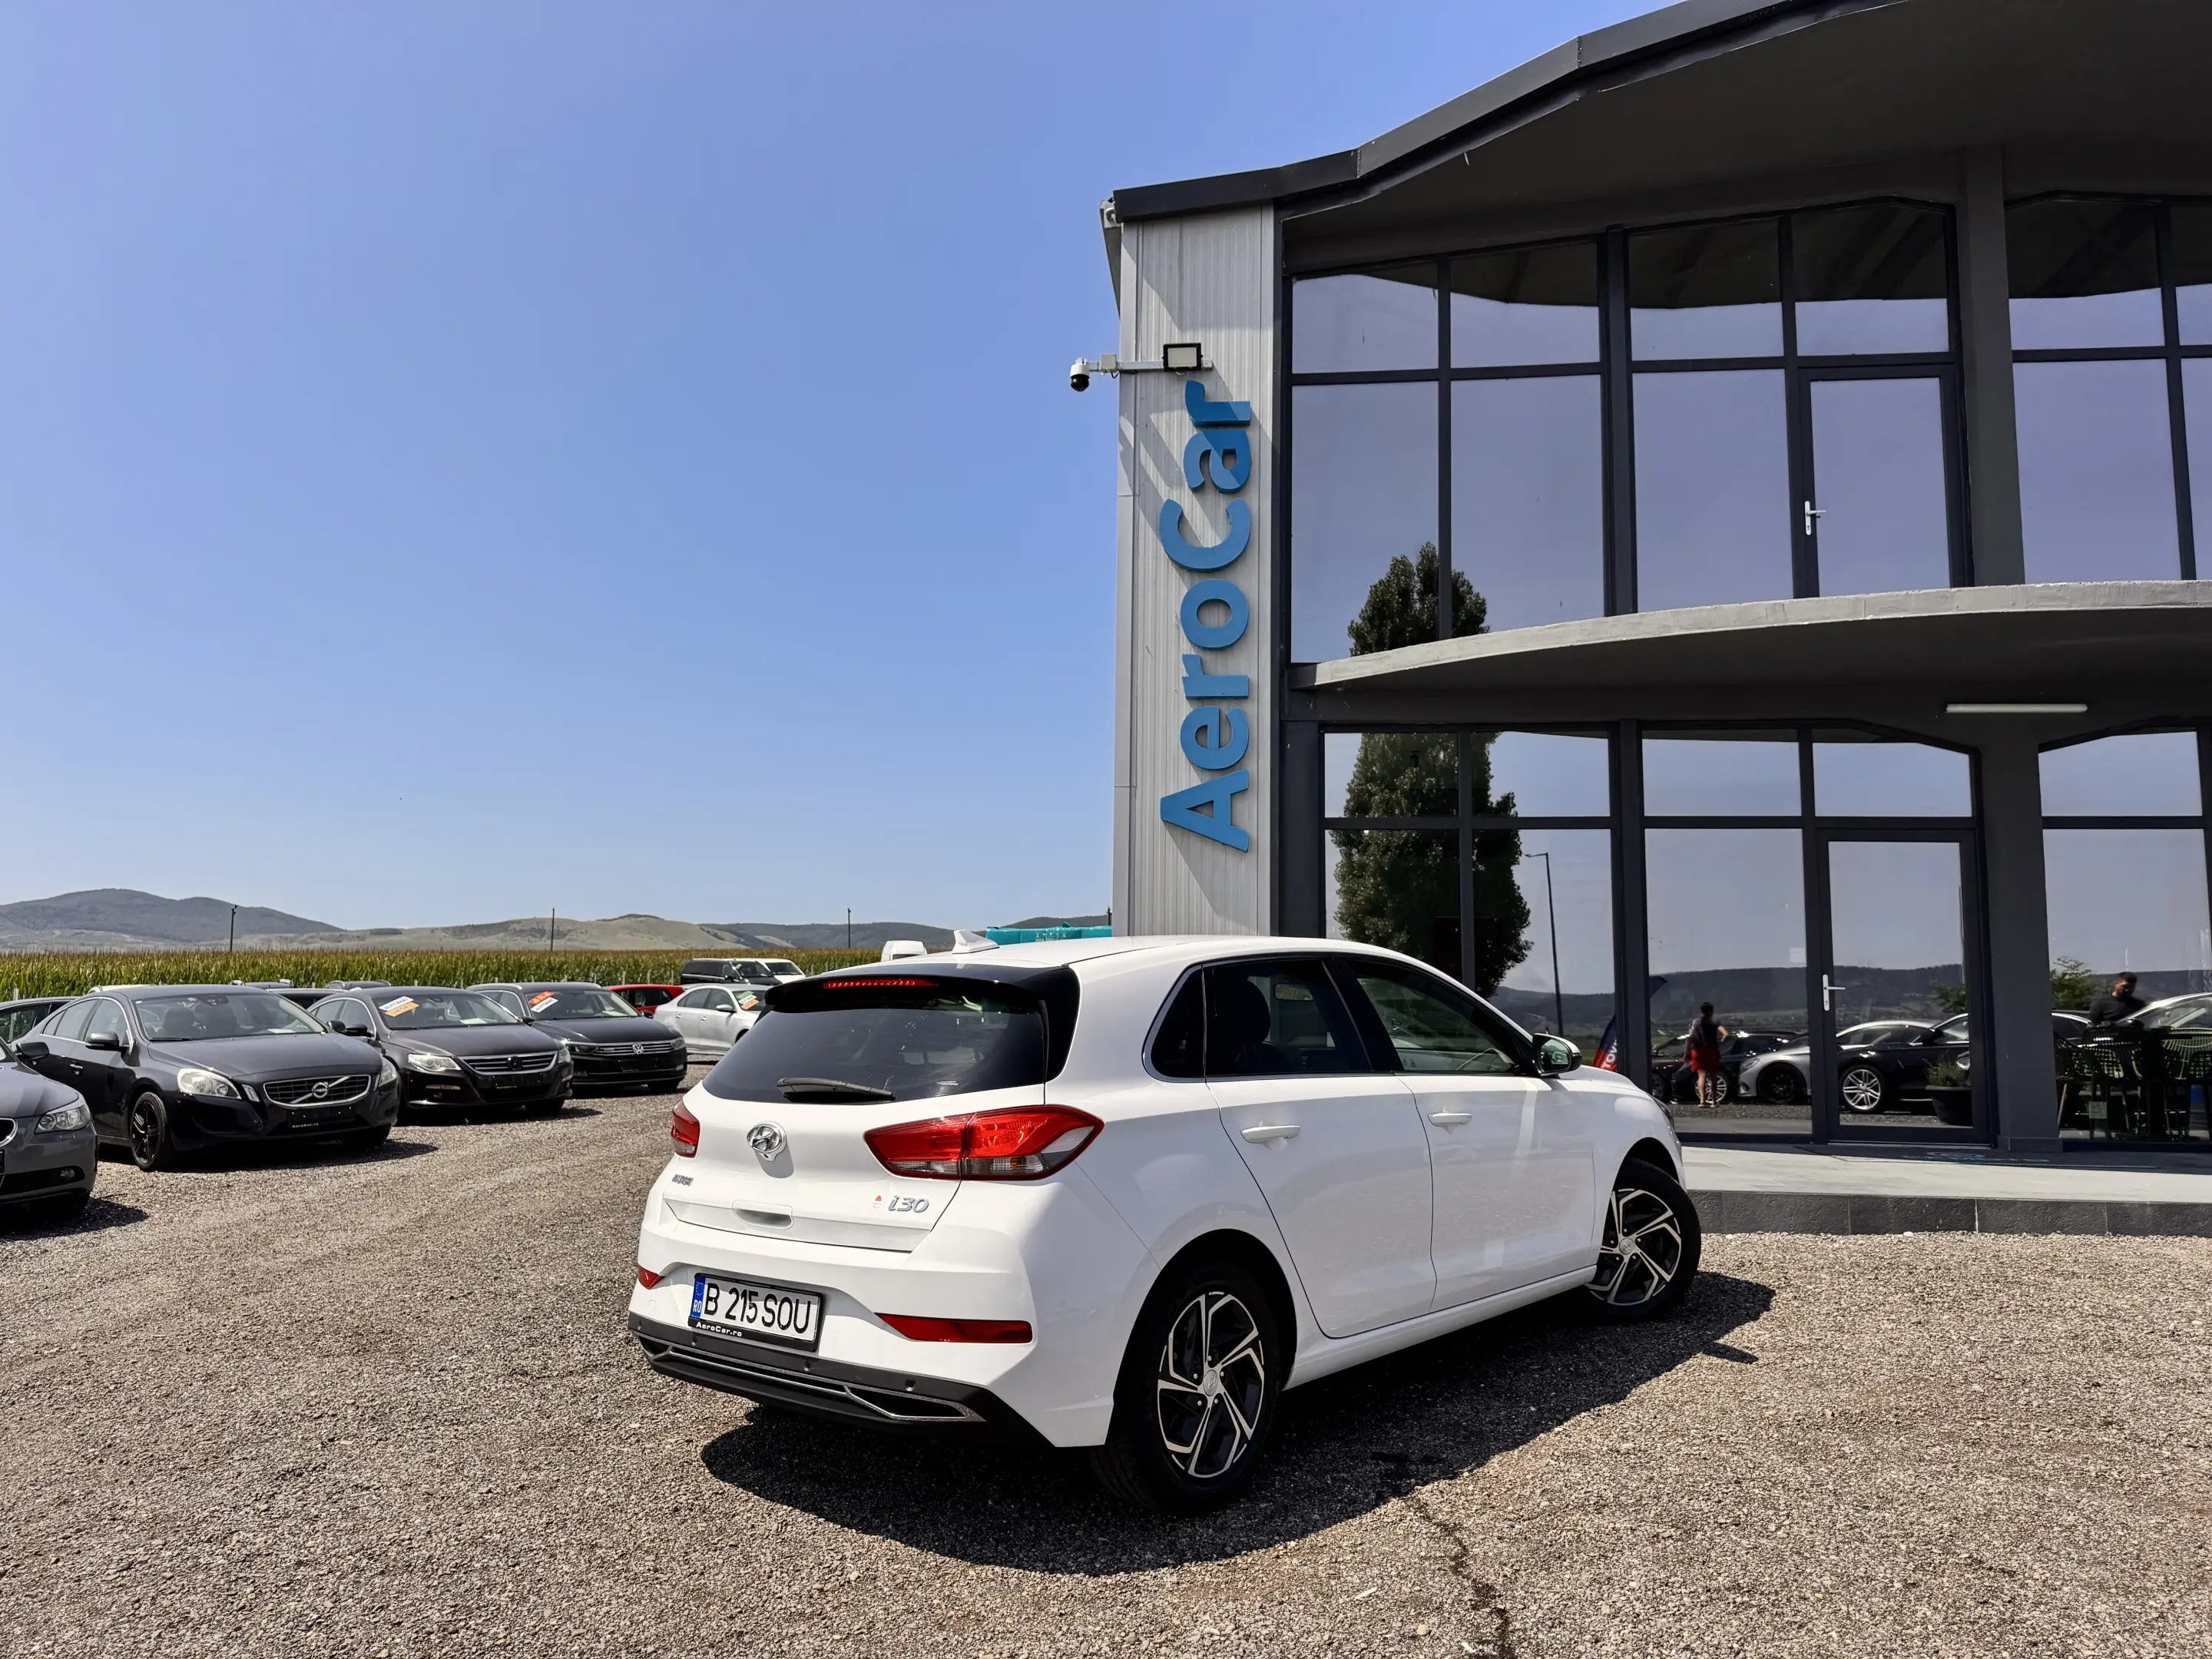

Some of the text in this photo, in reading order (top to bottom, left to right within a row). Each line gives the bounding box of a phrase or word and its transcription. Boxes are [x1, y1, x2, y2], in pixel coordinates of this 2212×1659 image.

[1159, 379, 1251, 853] AeroCar
[888, 1194, 929, 1214] i30
[693, 1299, 702, 1313] RO
[704, 1282, 812, 1334] B 215 SOU
[695, 1321, 743, 1338] AeroCar.ro
